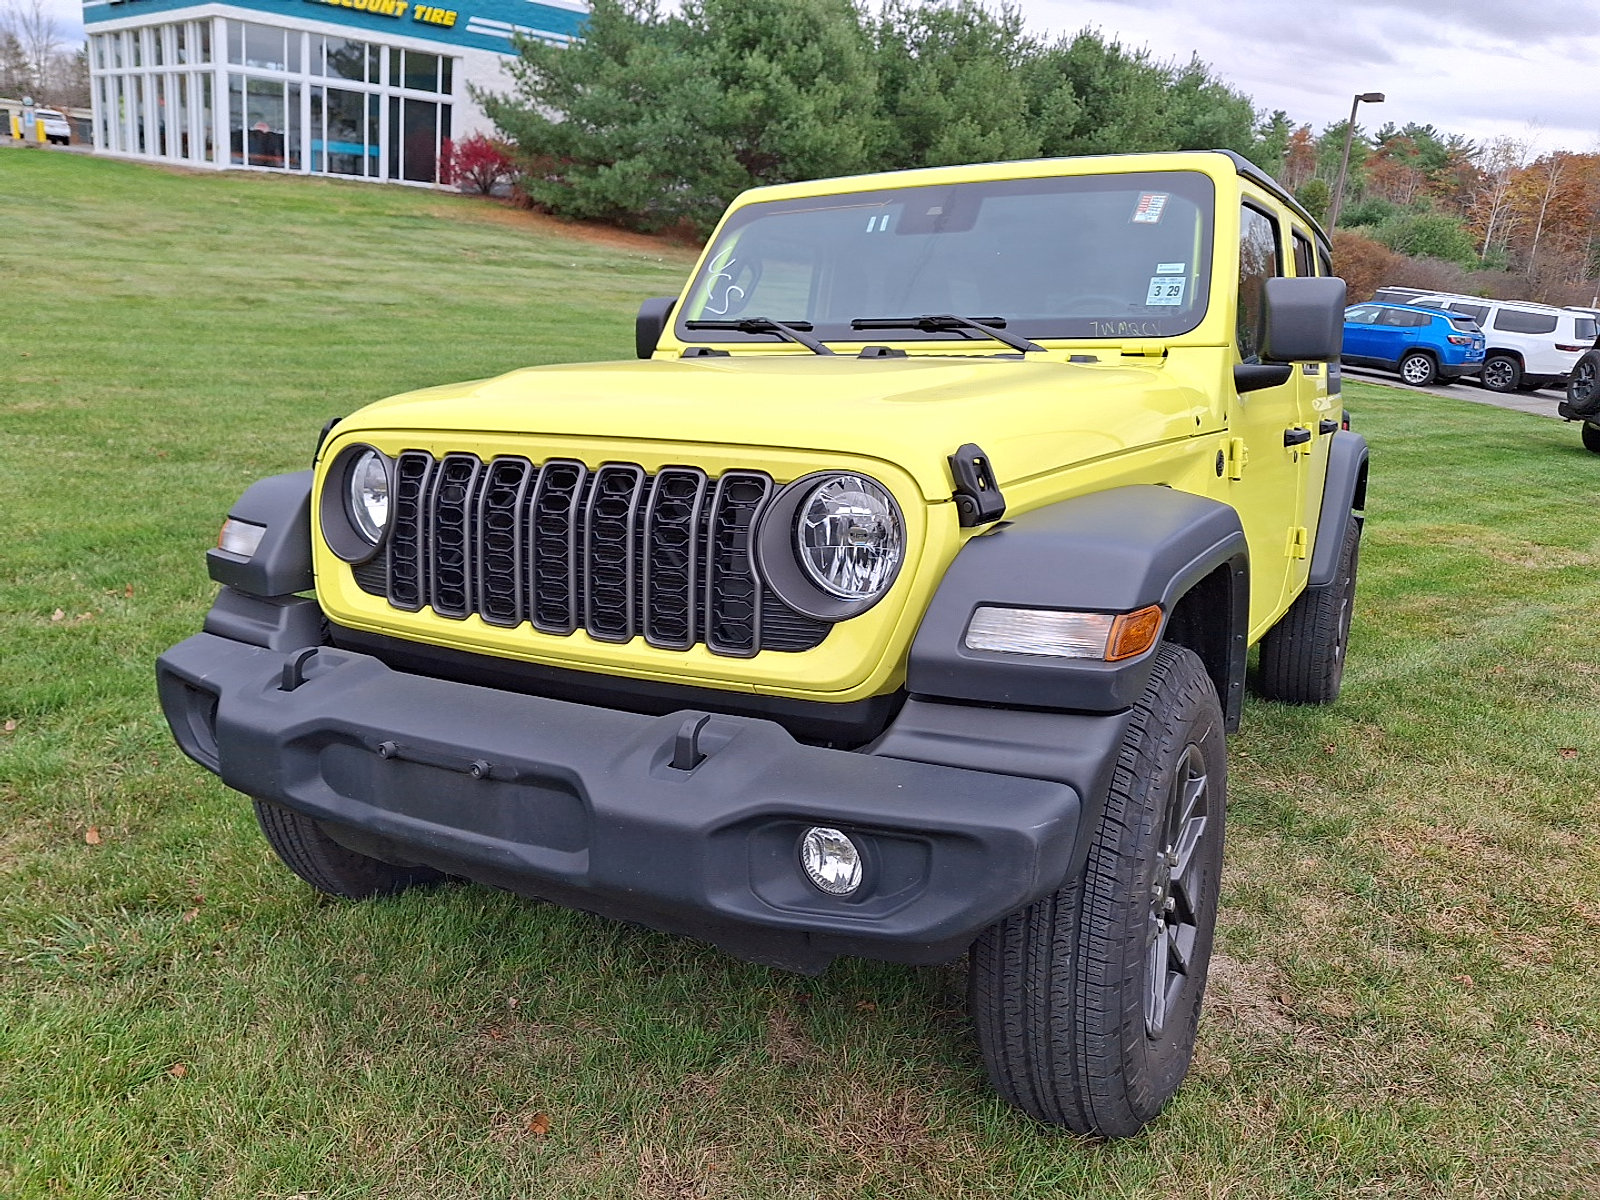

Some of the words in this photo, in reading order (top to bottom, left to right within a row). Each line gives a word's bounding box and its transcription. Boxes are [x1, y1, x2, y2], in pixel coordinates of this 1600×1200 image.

[414, 4, 458, 27] TIRE
[1154, 285, 1162, 297] 3
[1166, 285, 1180, 297] 29
